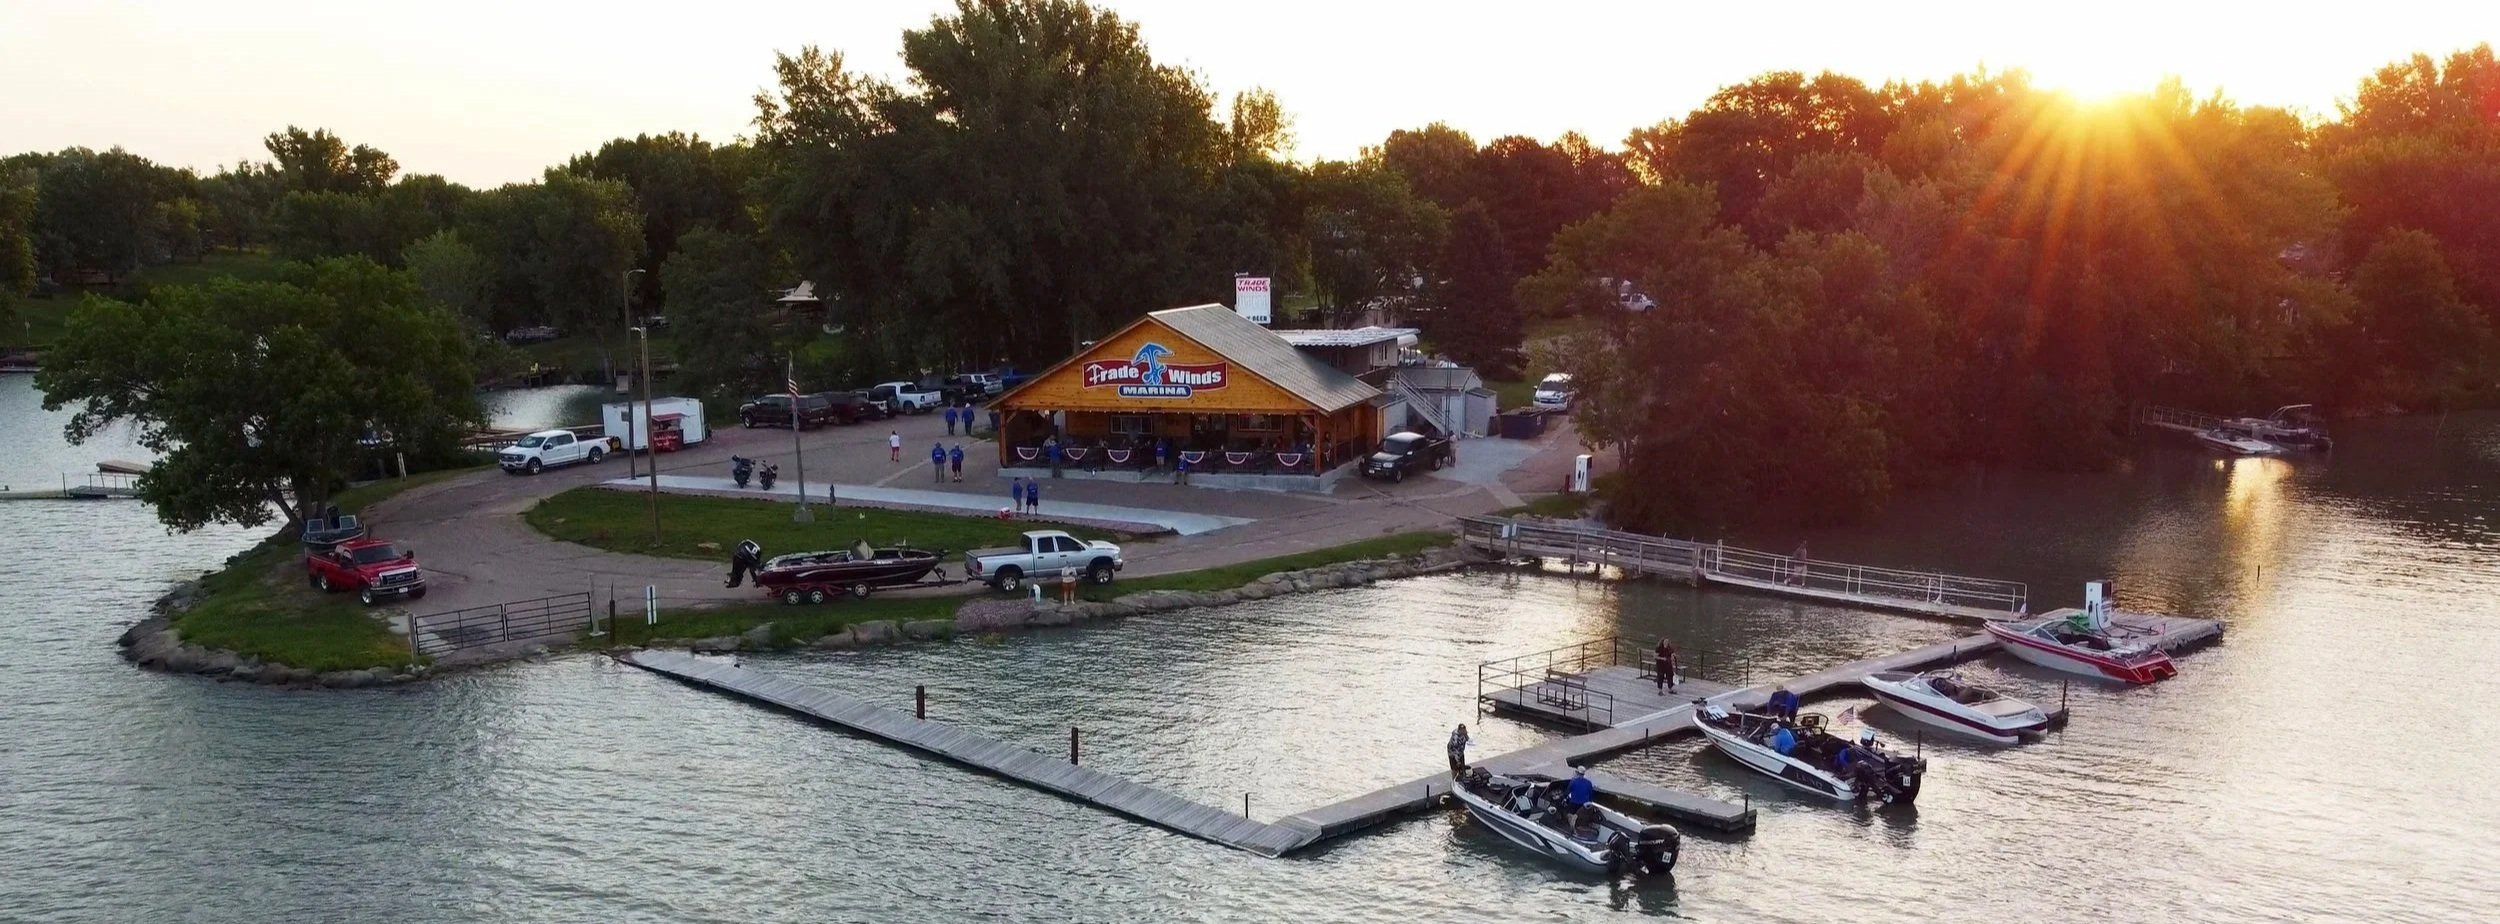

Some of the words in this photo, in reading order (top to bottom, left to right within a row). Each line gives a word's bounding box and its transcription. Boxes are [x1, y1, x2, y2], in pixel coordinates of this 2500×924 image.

[1086, 363, 1139, 385] Trade
[1168, 369, 1222, 385] Winds
[1123, 386, 1188, 395] MARINA
